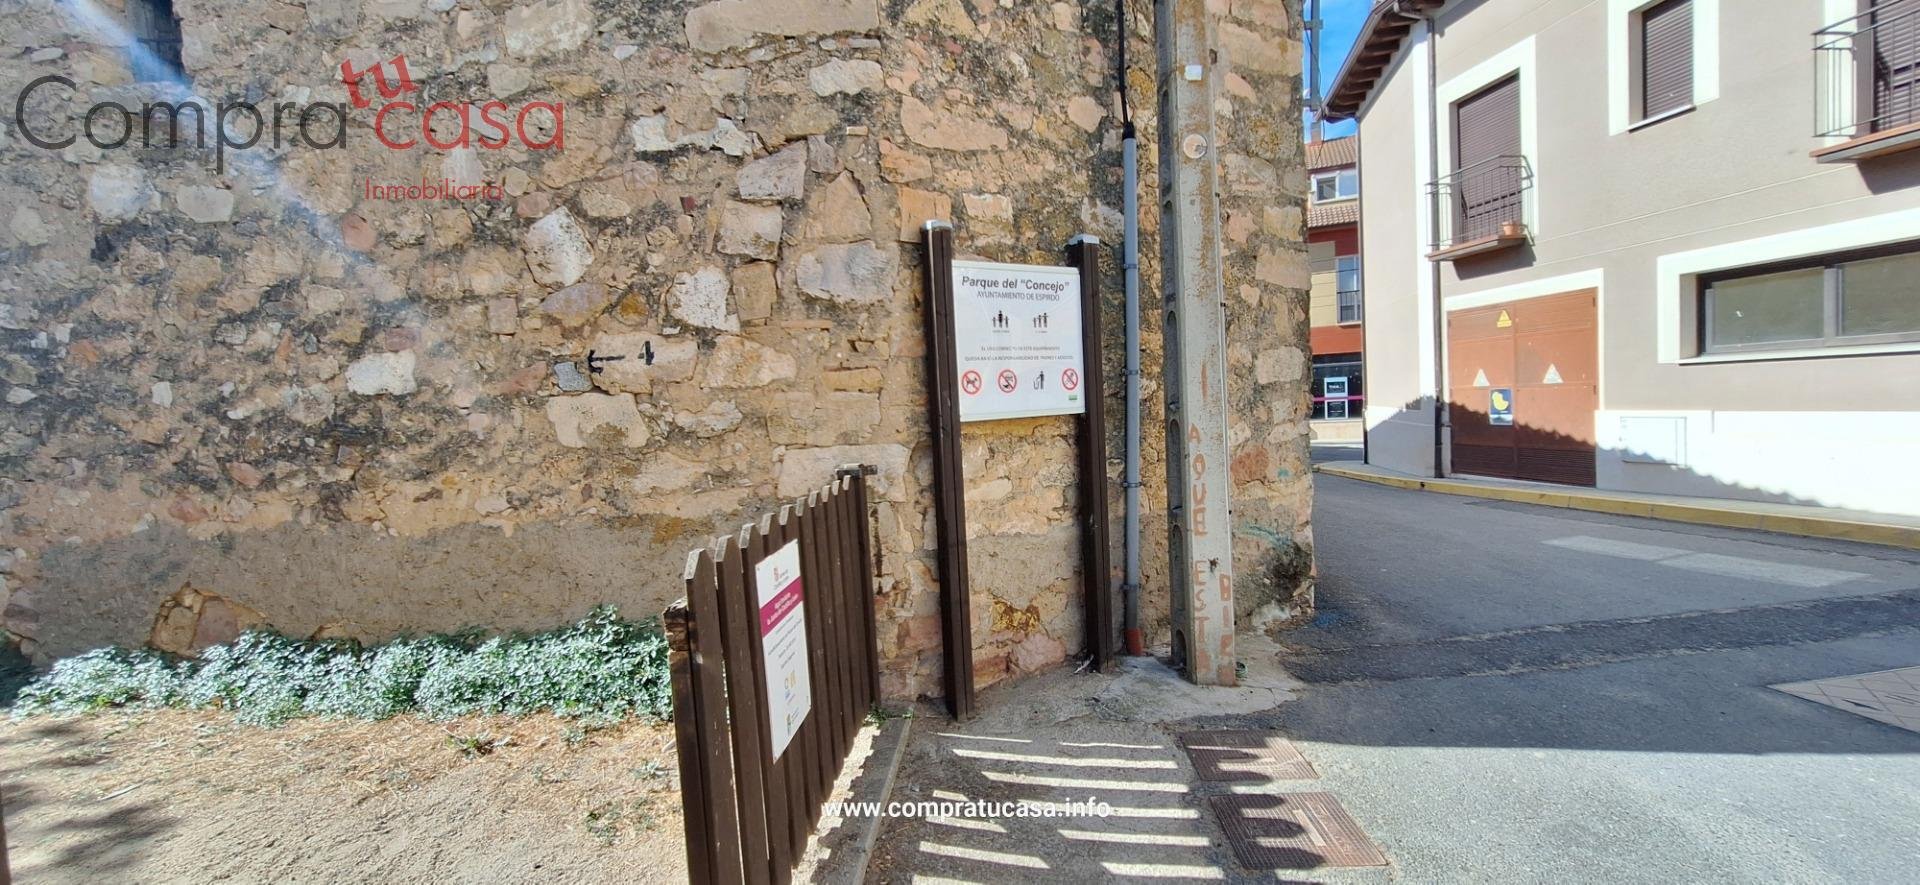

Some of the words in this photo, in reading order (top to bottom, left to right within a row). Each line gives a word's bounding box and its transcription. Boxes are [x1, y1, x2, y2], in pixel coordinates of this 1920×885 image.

[961, 276, 999, 290] Parque
[1002, 278, 1018, 289] del
[976, 290, 1025, 301] AYUNTAMIENTO
[1026, 292, 1035, 301] DE
[1035, 293, 1060, 302] ESPIRDO
